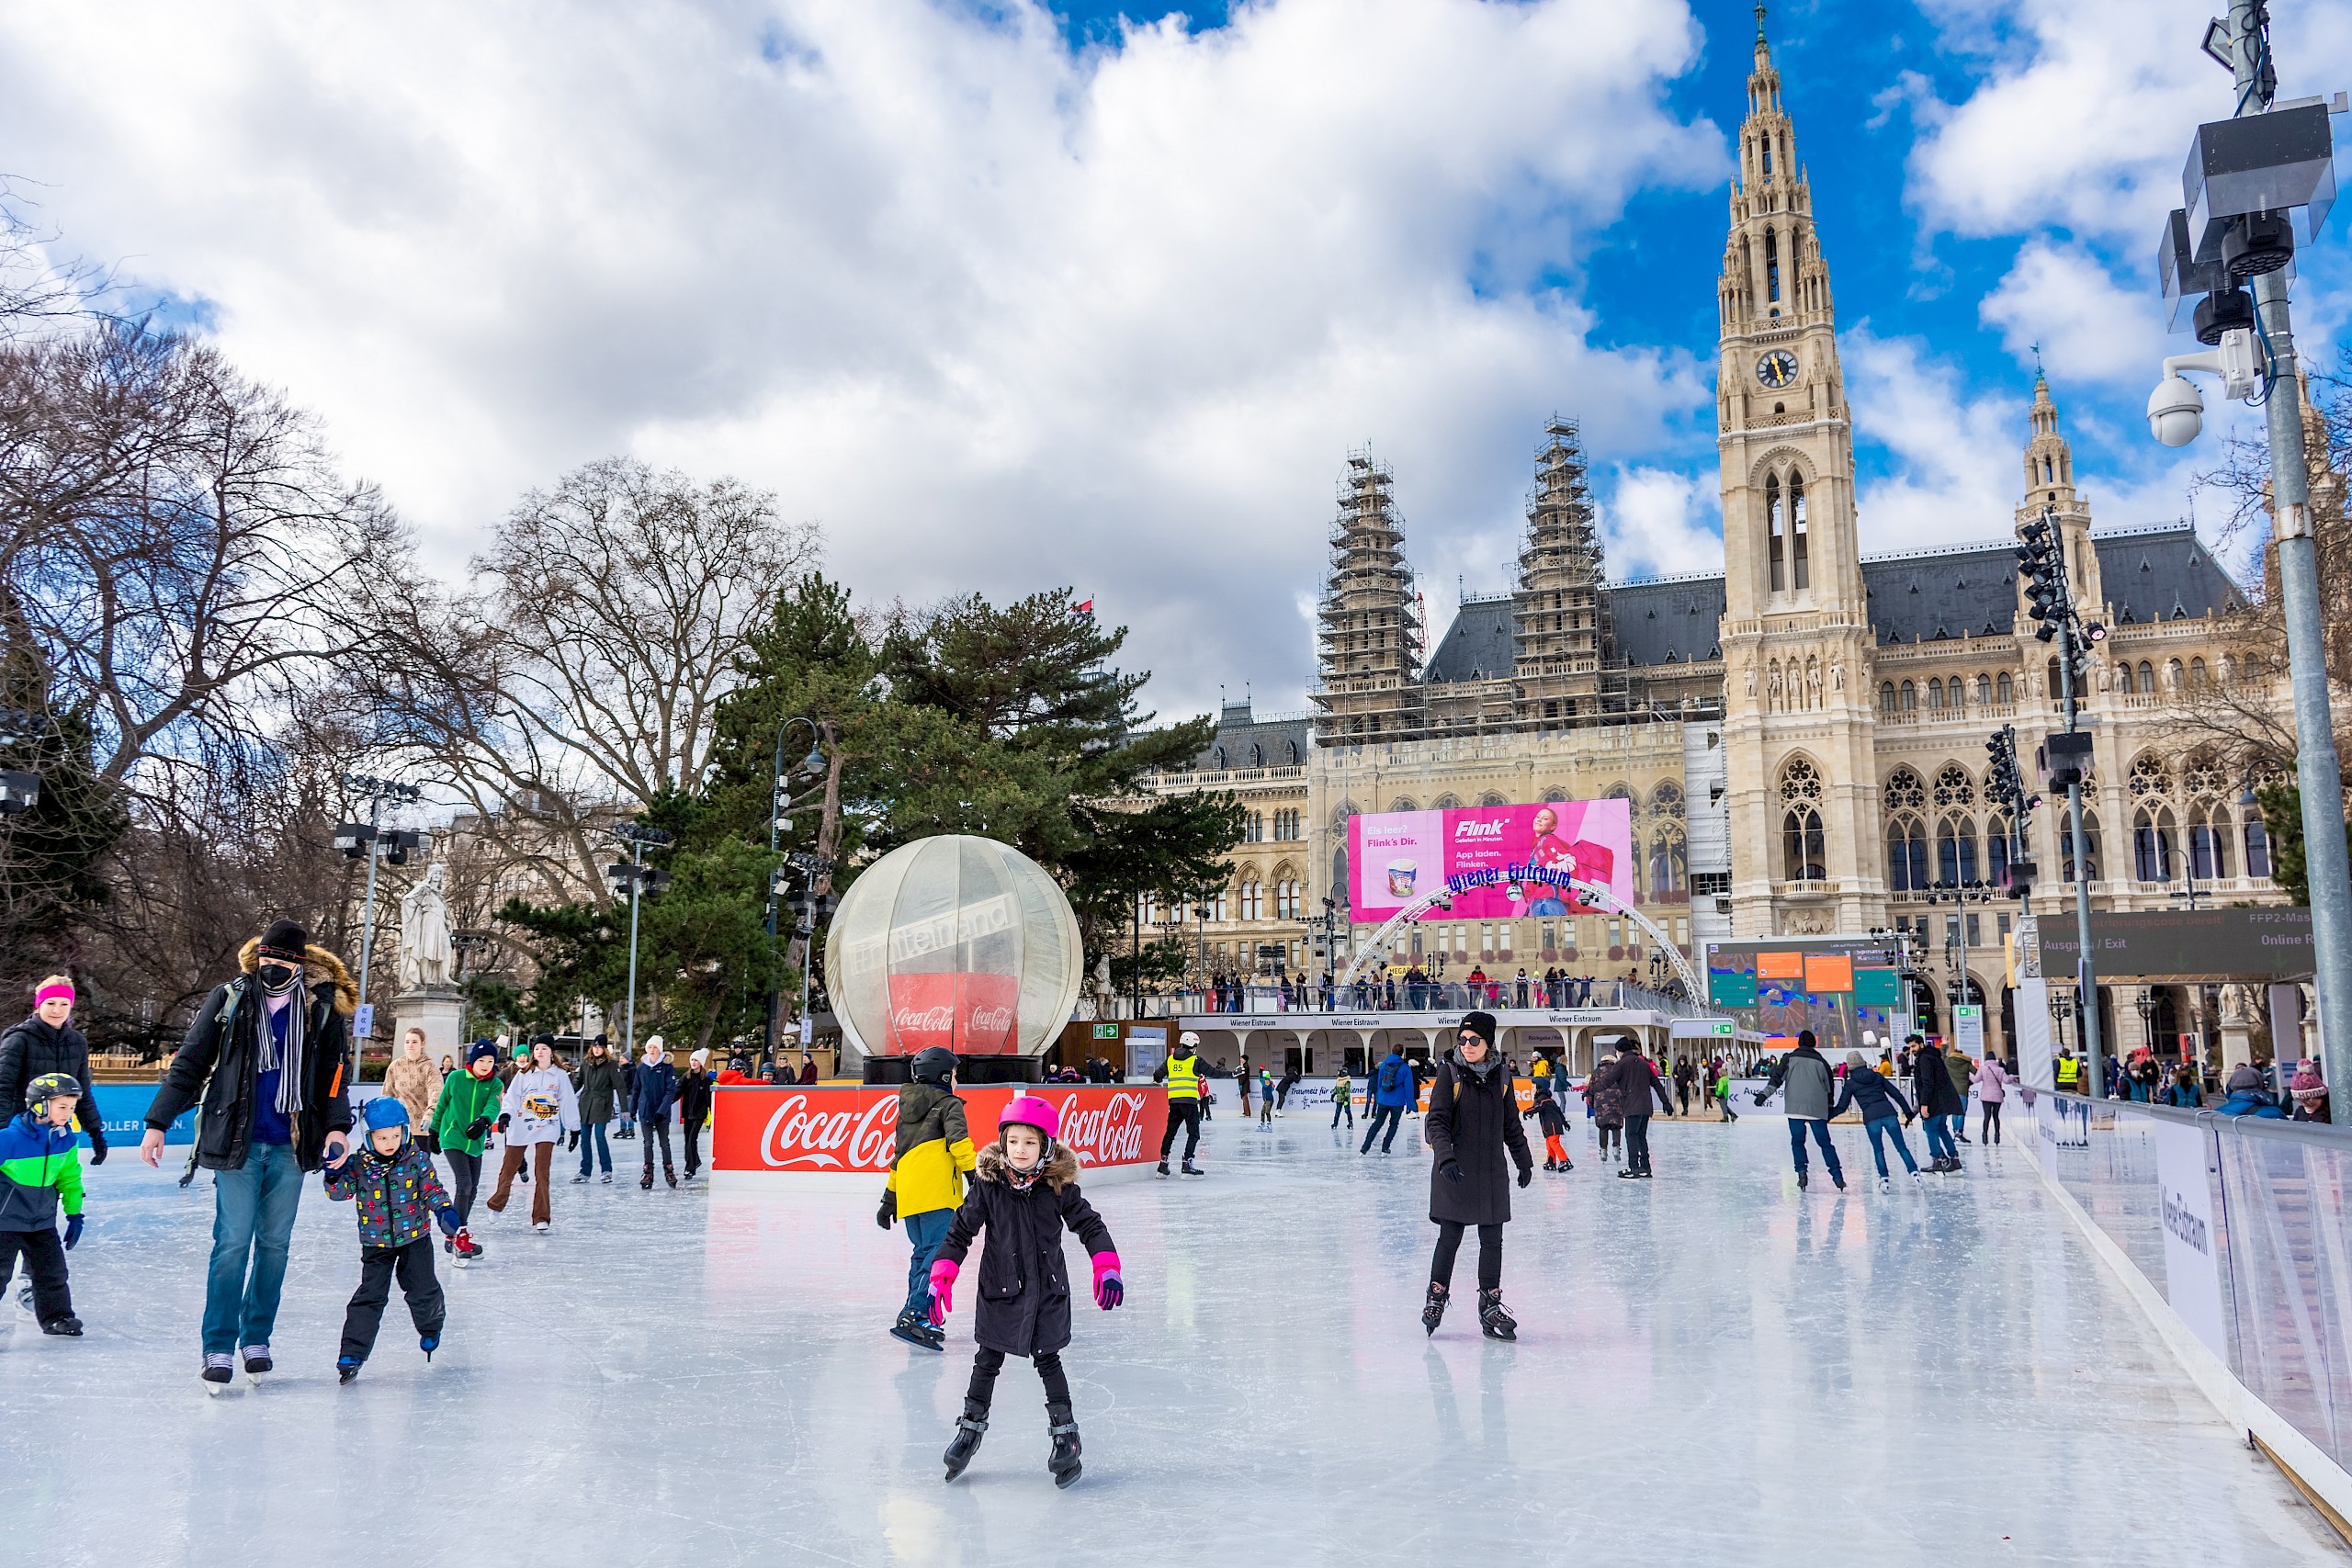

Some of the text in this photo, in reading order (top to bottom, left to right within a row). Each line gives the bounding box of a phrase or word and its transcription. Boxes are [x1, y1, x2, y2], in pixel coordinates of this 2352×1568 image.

[1367, 825, 1408, 835] Eis leer?
[1455, 819, 1505, 837] Flink
[1367, 838, 1418, 847] Flink's Dir.
[1456, 852, 1473, 860] App
[1447, 862, 1571, 891] Wiener Eistraum
[2249, 913, 2311, 923] FFP2-Mas
[2261, 934, 2301, 945] Online
[2044, 940, 2094, 953] Ausga
[2105, 938, 2127, 949] Exit
[896, 1006, 956, 1032] Coca-Cola
[972, 1006, 1012, 1032] Coca-Cola
[1574, 1014, 1602, 1022] Eistraum
[1172, 1064, 1182, 1072] 85
[1291, 1087, 1317, 1095] Traumeis
[1319, 1086, 1329, 1096] für
[1351, 1086, 1366, 1094] iener
[101, 1120, 139, 1132] OLLER
[760, 1094, 900, 1168] Coca-Co
[1057, 1092, 1147, 1164] Coca-Cola
